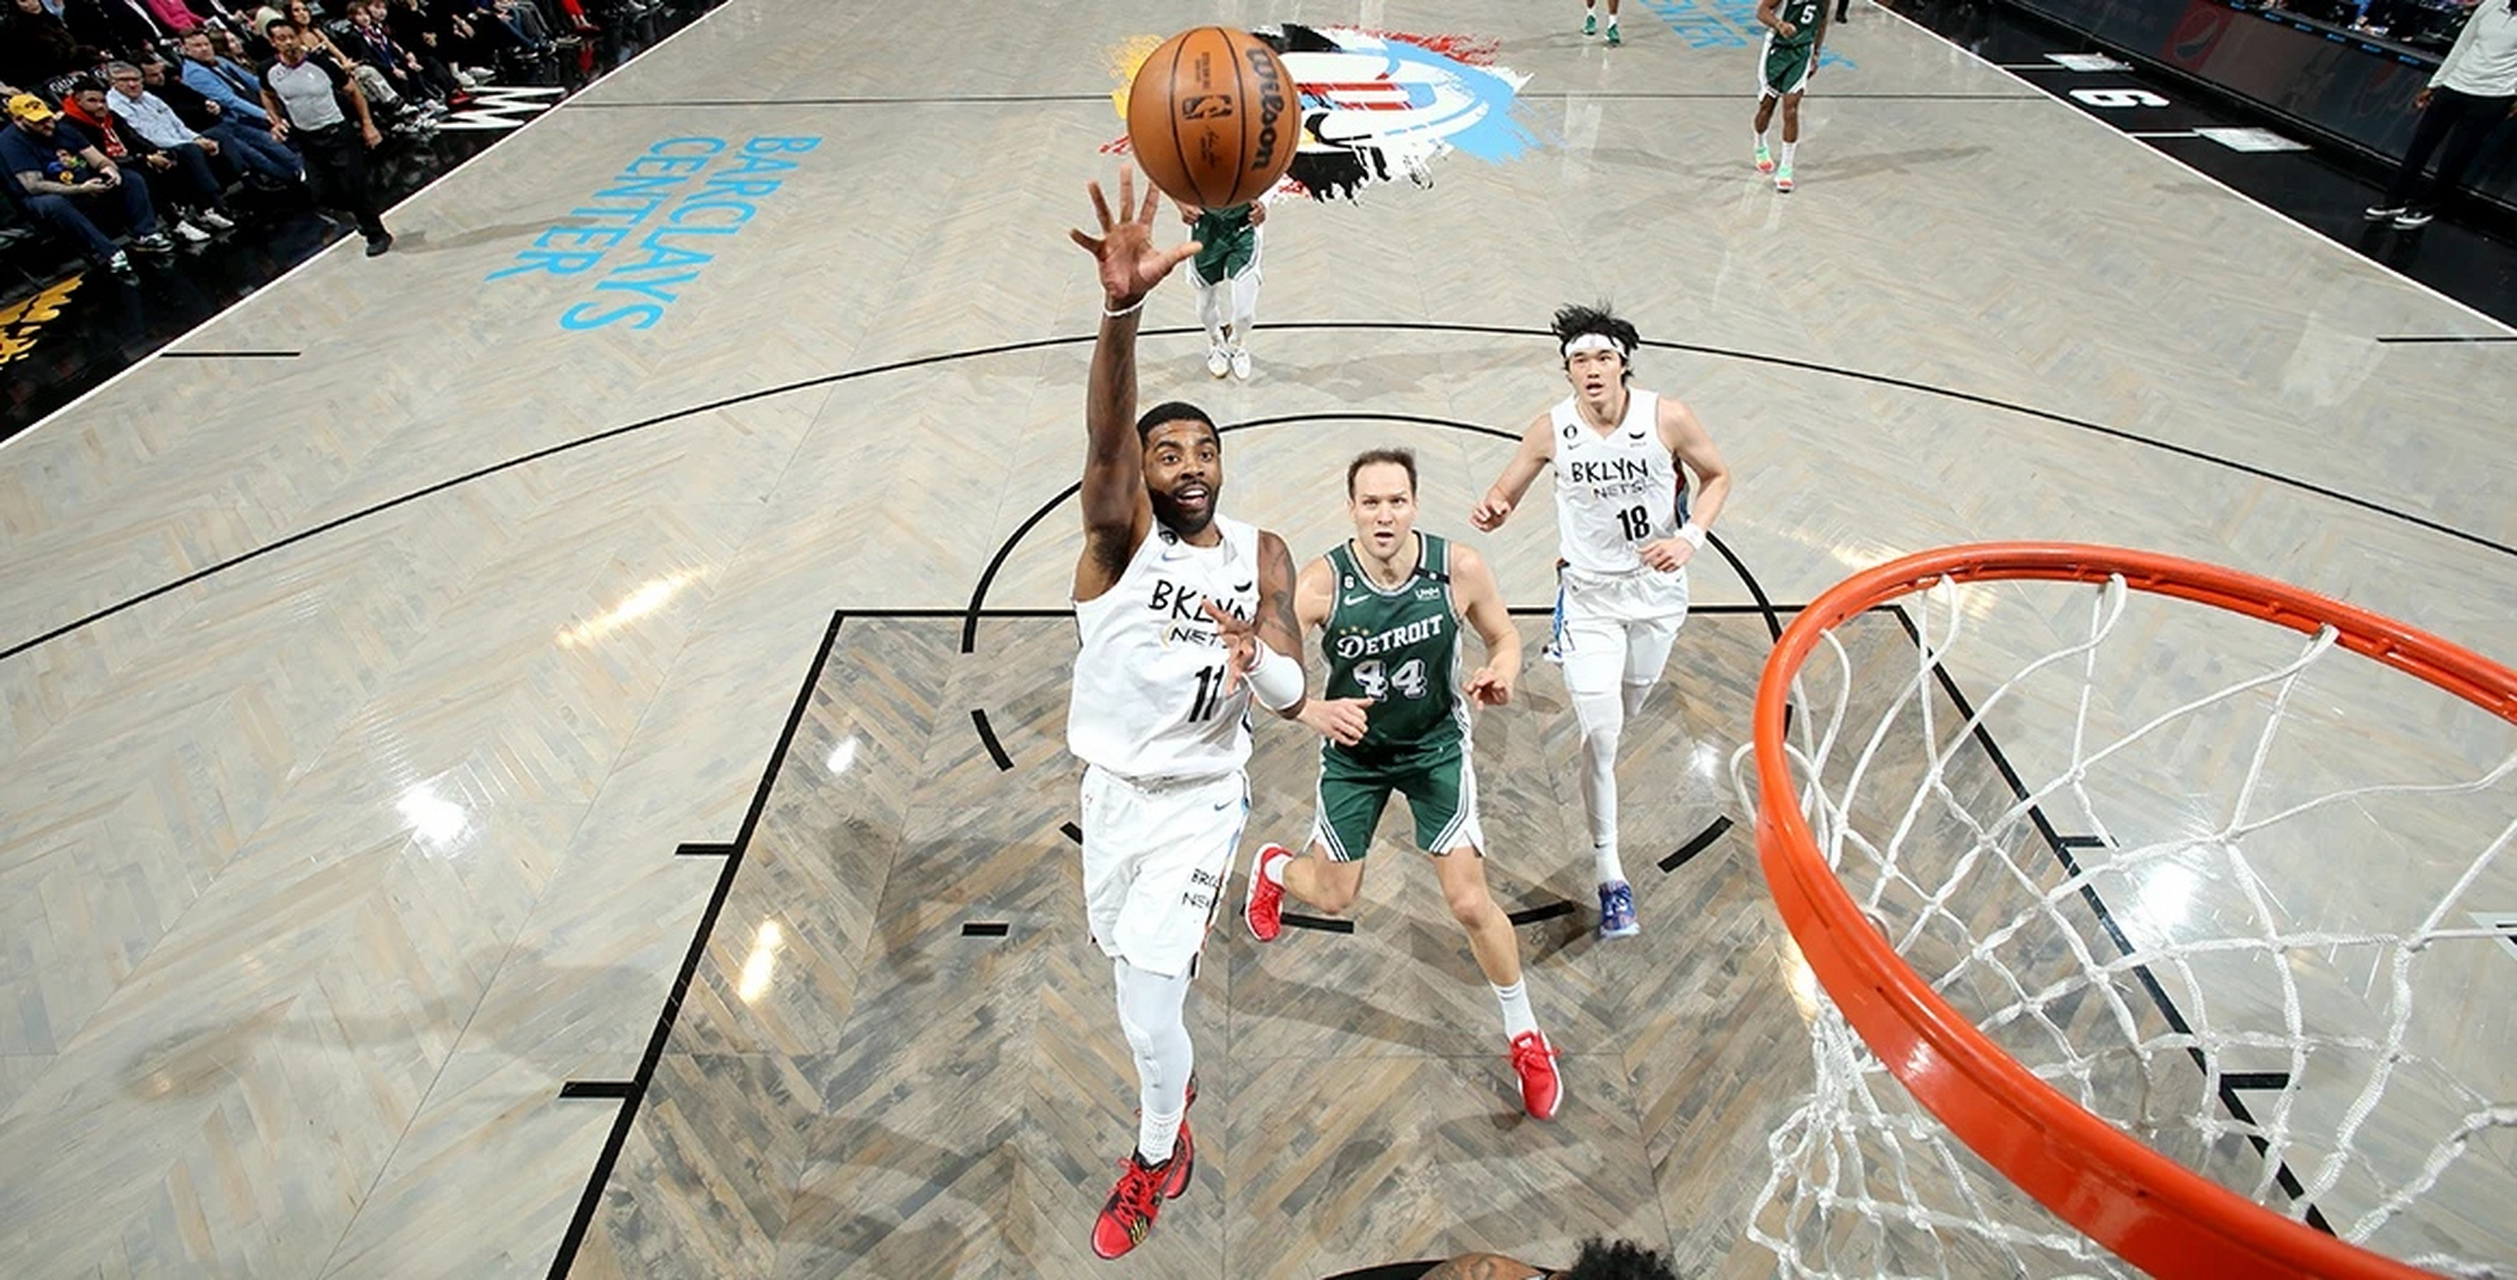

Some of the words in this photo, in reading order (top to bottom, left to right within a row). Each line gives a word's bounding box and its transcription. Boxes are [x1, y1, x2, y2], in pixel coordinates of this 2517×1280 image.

[1800, 4, 1817, 24] 5
[1245, 48, 1285, 172] Wilson
[484, 136, 728, 281] CENTER
[559, 136, 824, 331] BARCLAYS
[1571, 458, 1649, 482] BKLYN
[1593, 479, 1645, 499] NETS
[1616, 504, 1650, 541] 18
[1169, 626, 1228, 649] NET
[1336, 614, 1443, 658] DETROIT
[1188, 664, 1225, 722] 11
[1353, 658, 1427, 702] 44
